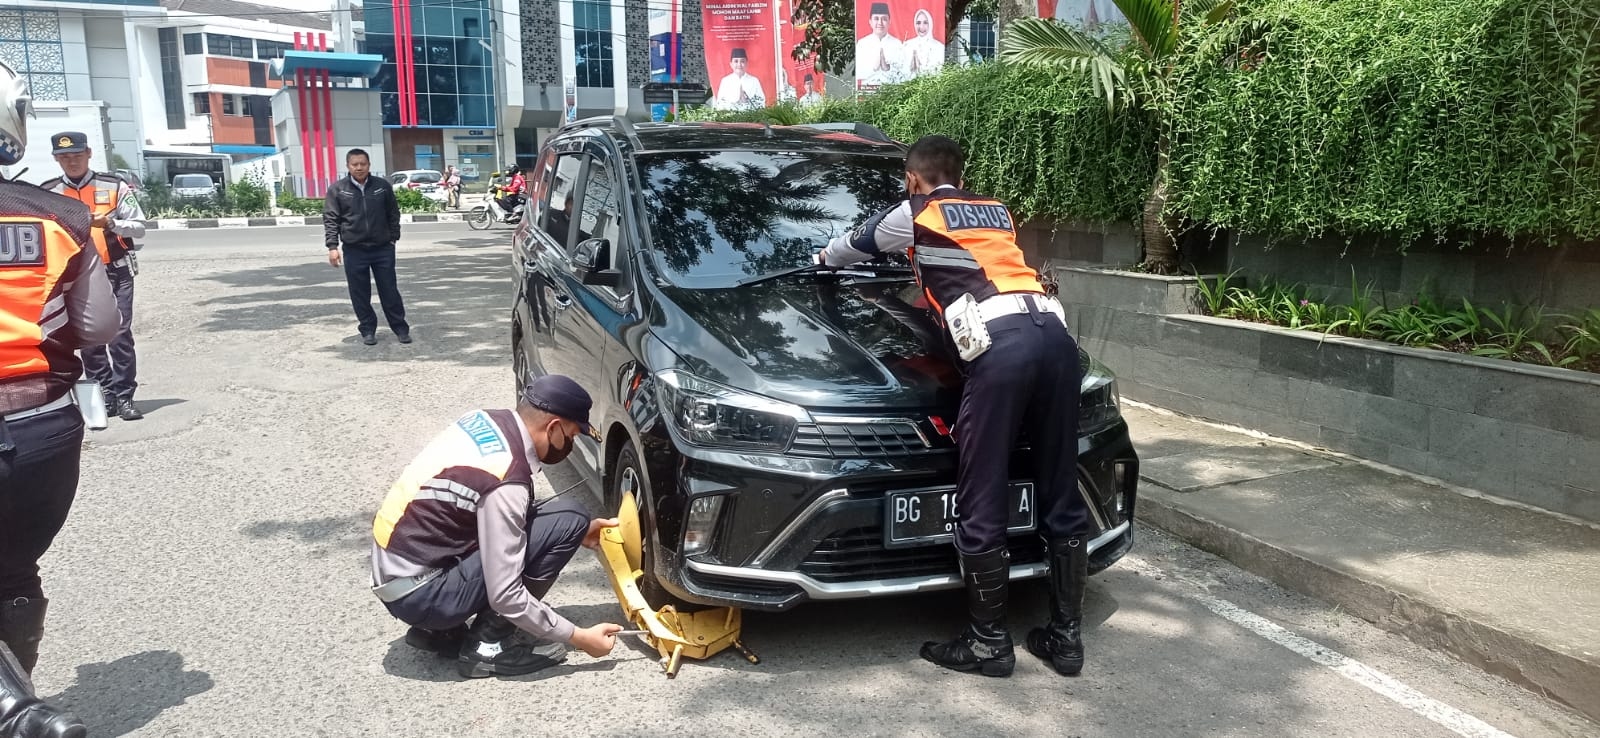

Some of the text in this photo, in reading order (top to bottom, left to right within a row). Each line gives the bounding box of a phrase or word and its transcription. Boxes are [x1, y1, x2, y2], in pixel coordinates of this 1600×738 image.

[943, 204, 1010, 228] DISHUB
[459, 412, 504, 454] DISHUB
[896, 496, 921, 523] BG
[1018, 488, 1029, 513] A
